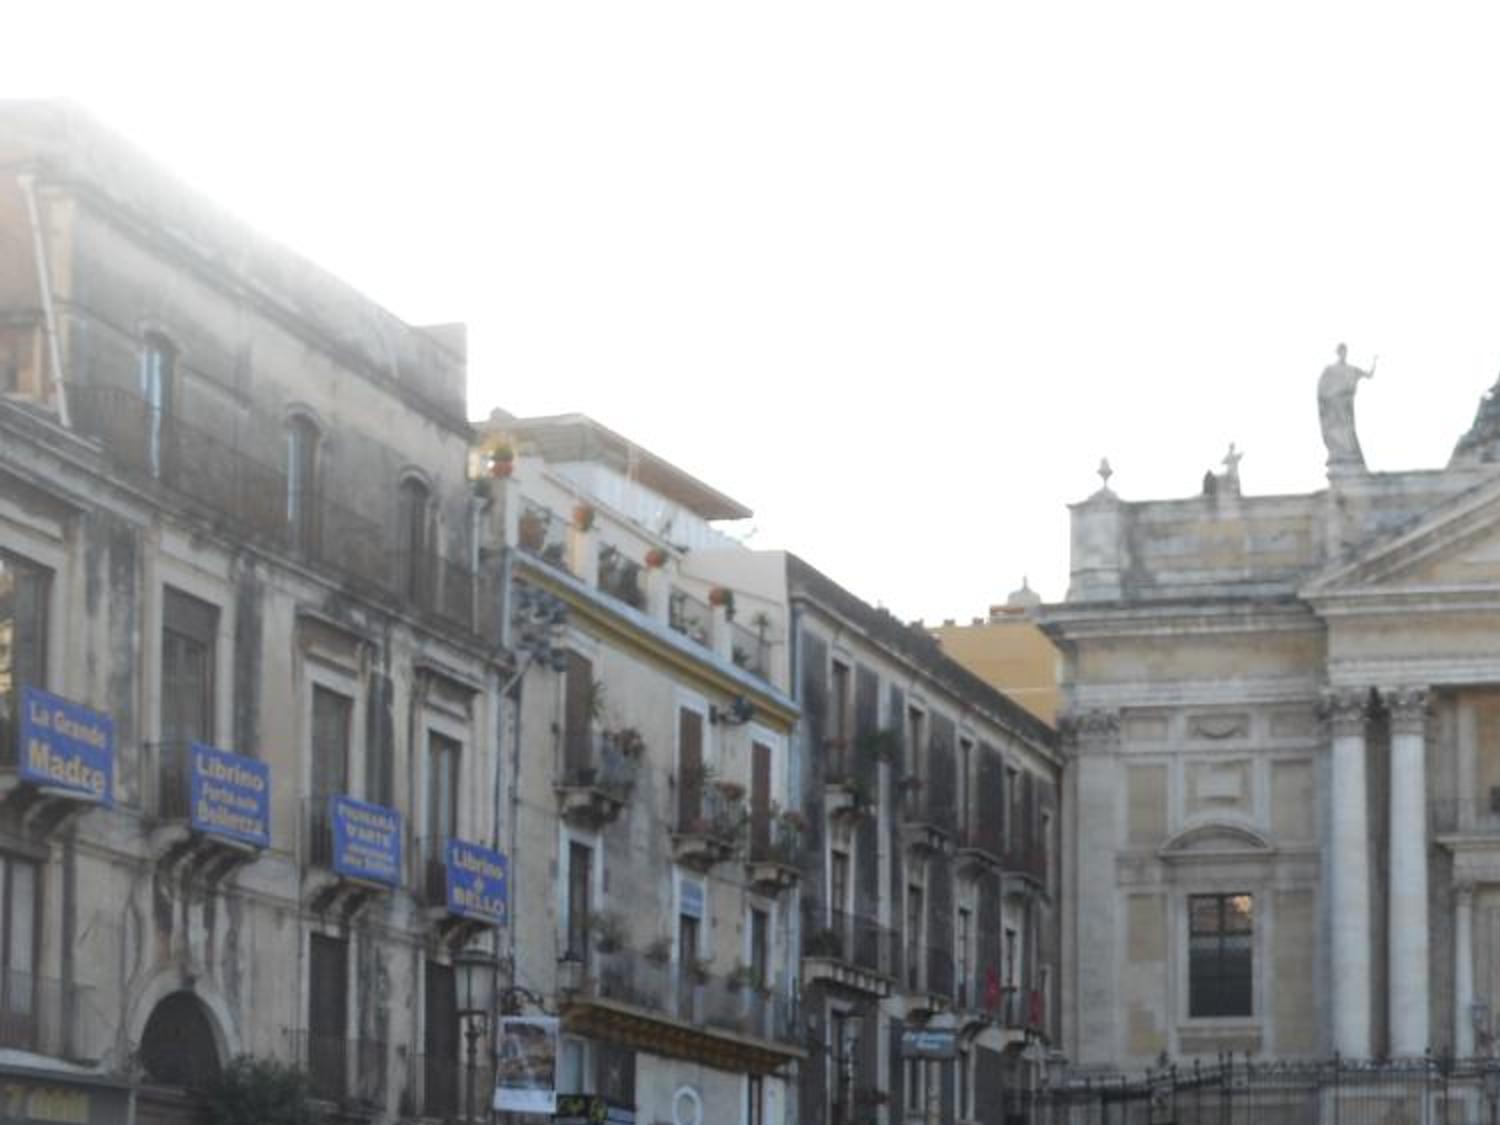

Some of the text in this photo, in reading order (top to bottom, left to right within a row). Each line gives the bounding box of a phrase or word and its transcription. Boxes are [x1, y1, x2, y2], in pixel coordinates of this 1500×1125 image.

[29, 738, 107, 794] Madre
[196, 752, 264, 791] Librino
[452, 847, 505, 880] Librino
[452, 886, 505, 915] BELLO
